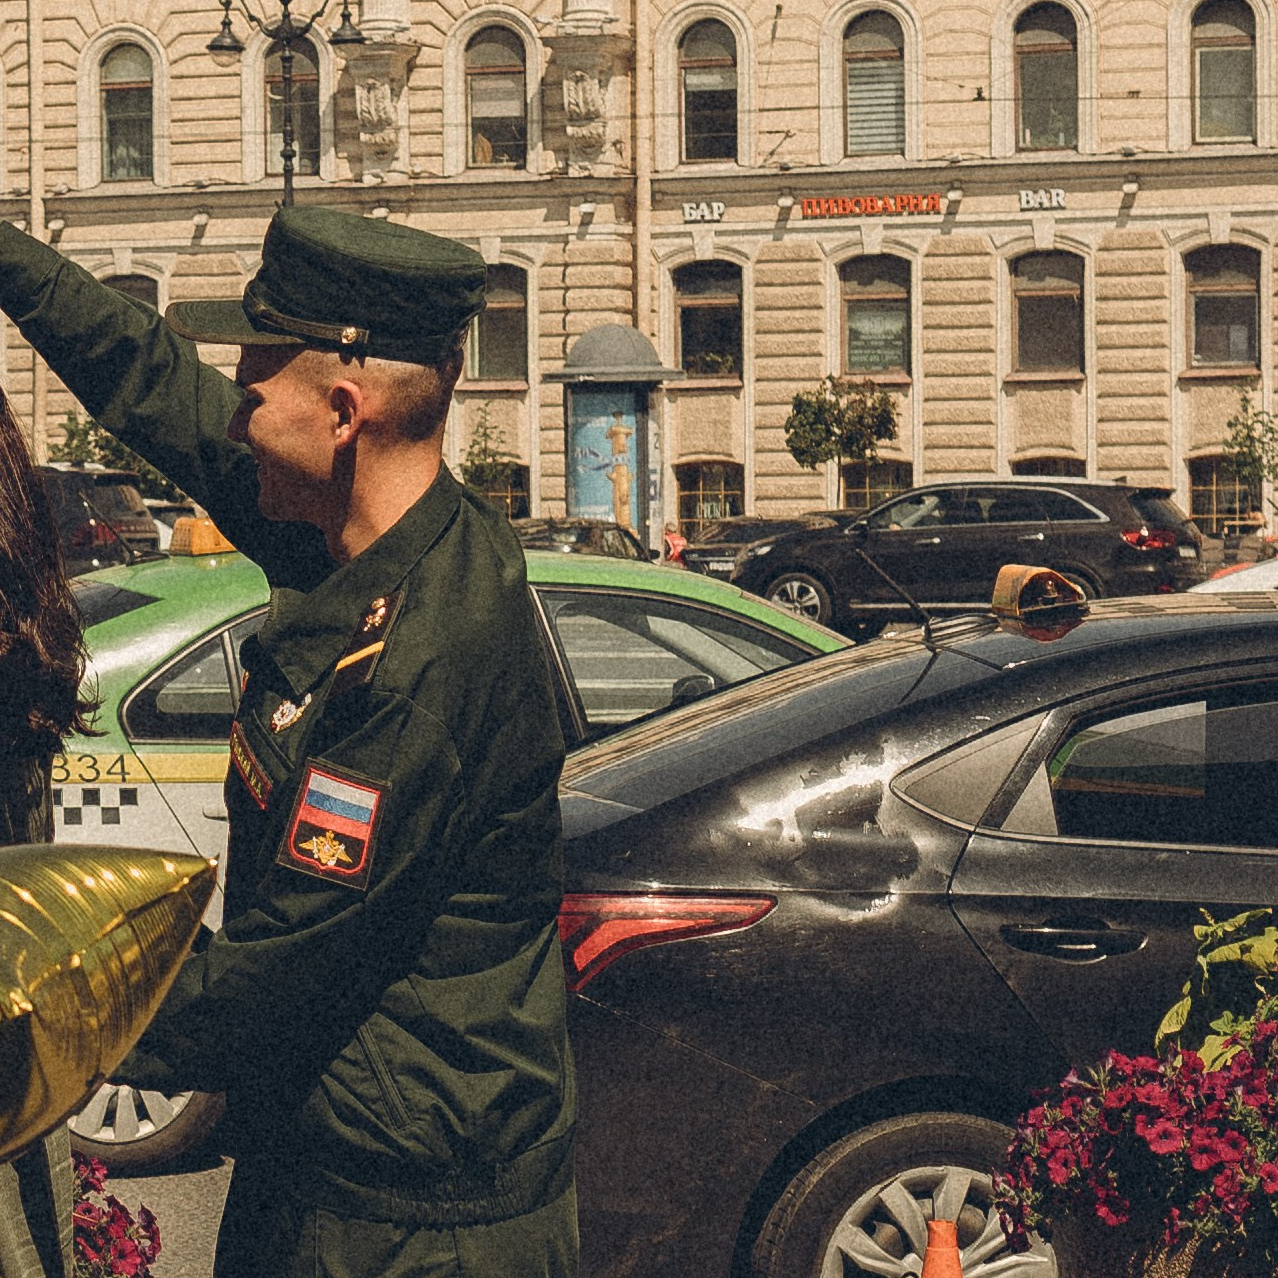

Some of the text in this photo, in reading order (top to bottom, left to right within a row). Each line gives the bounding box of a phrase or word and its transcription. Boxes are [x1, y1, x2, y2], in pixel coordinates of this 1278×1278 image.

[802, 193, 941, 216] ПИВОВАРНЯ
[1019, 188, 1067, 209] BAR
[682, 202, 726, 221] БАР
